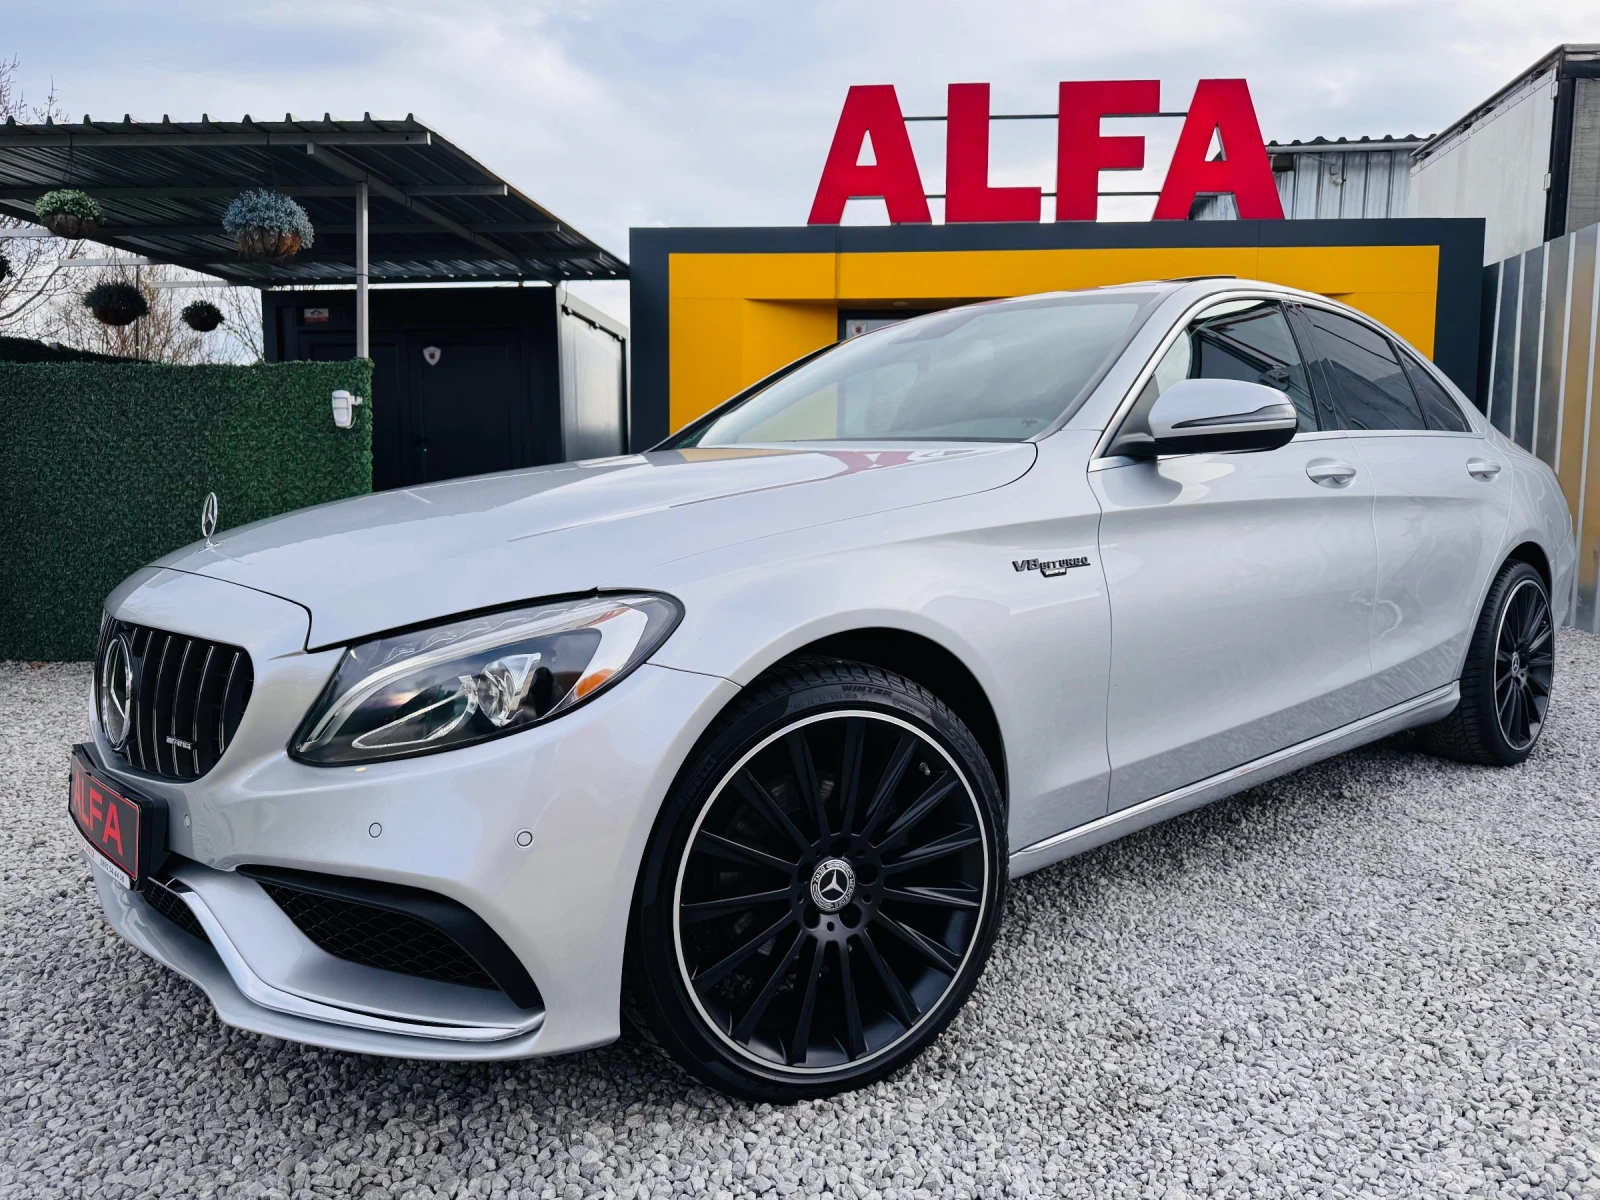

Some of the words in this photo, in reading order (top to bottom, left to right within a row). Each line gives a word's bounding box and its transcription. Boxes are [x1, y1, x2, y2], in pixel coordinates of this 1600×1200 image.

[807, 79, 1285, 224] ALFA
[841, 684, 894, 699] WINTER
[73, 770, 124, 858] ALFA
